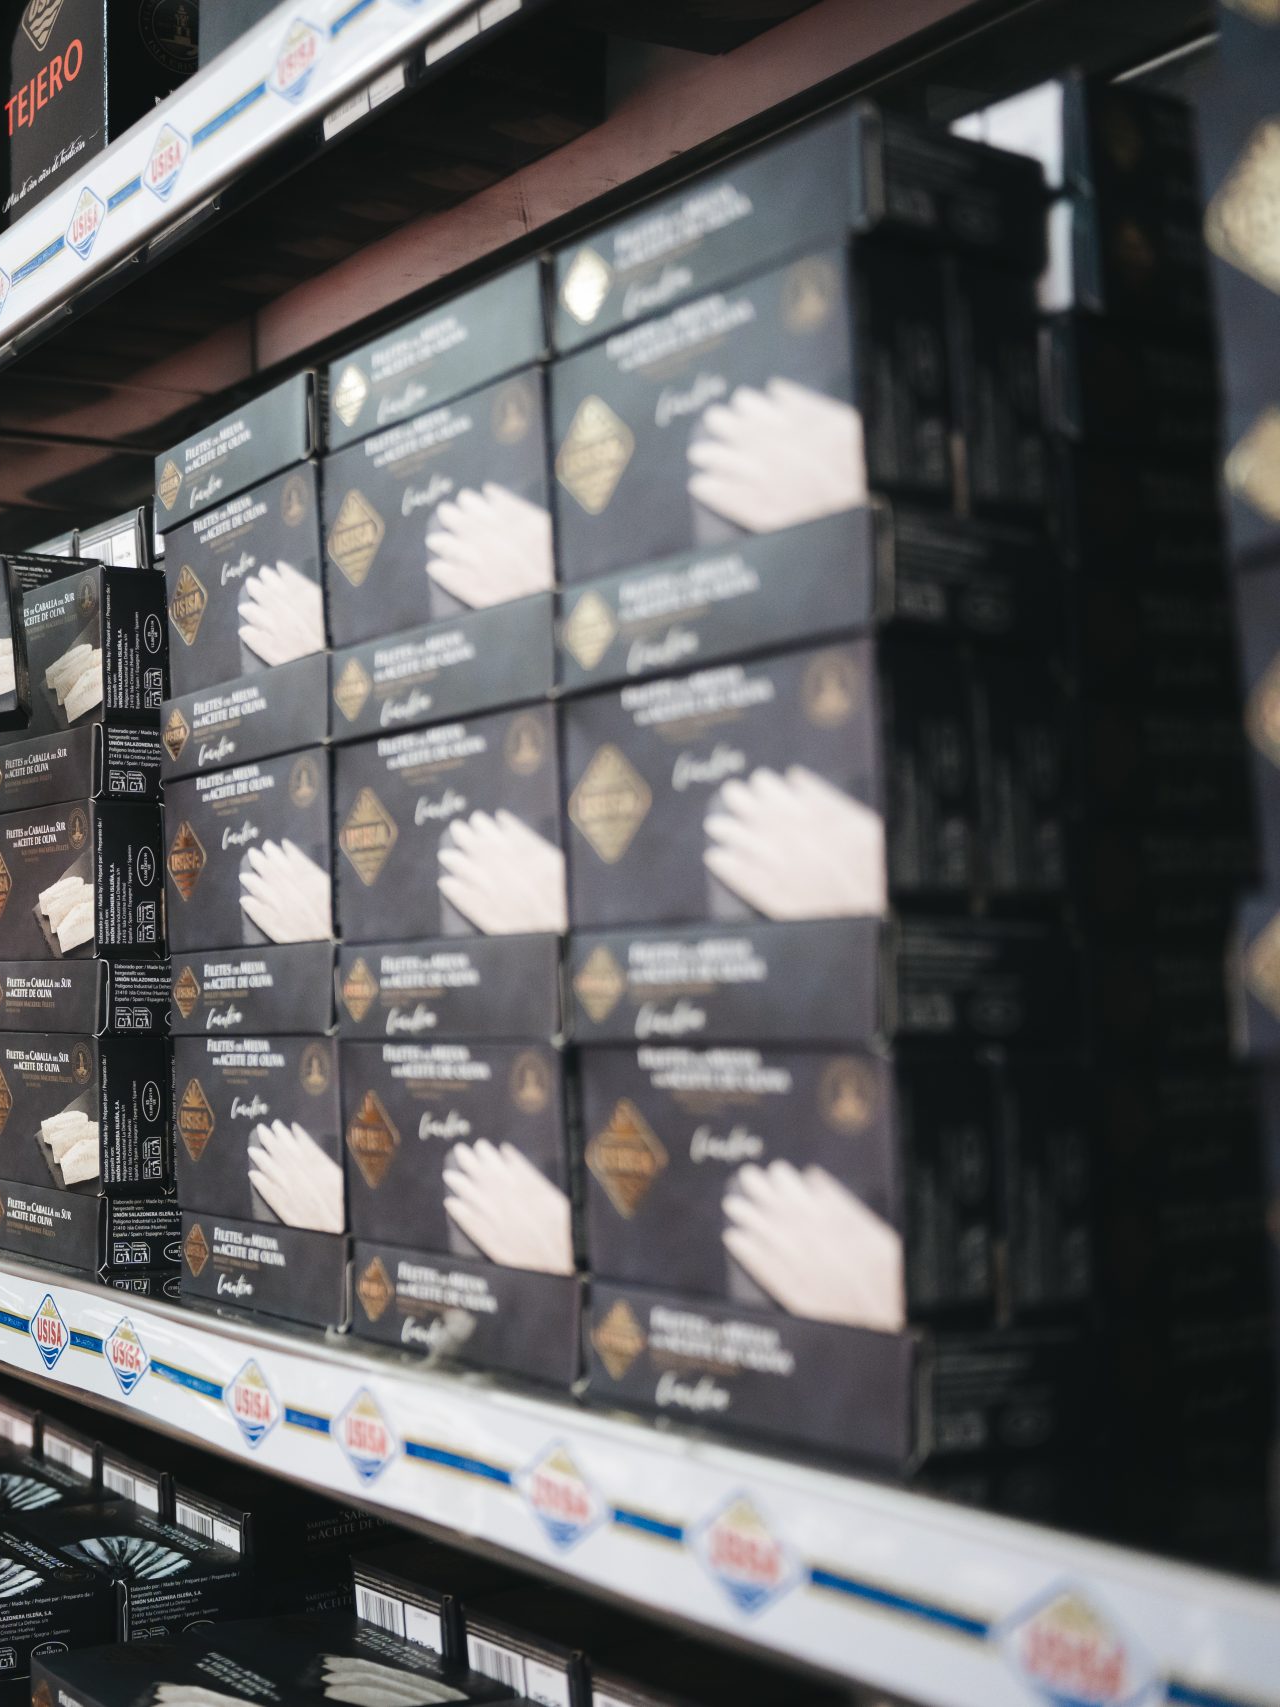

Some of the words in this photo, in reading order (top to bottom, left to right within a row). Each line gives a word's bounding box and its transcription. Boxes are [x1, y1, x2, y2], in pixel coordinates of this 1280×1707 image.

[278, 37, 316, 87] USISA
[5, 38, 83, 136] TEJERO
[150, 141, 182, 183] USISA
[72, 204, 99, 243] USISA
[5, 758, 23, 769] FILETES
[28, 752, 50, 764] CABALLA
[57, 748, 67, 758] SUR
[9, 767, 25, 777] ACEITE
[26, 765, 33, 774] DE
[34, 762, 49, 773] OLIVA
[6, 828, 23, 839] FILETES
[28, 825, 49, 835] CABALLA
[55, 821, 66, 831] SUR
[17, 837, 33, 847] ACEITE
[34, 836, 41, 844] DE
[42, 834, 56, 844] OLIVA
[6, 977, 25, 988] FILETES
[30, 977, 53, 988] CABALLA
[60, 977, 71, 988] SUR
[10, 988, 27, 998] ACEITE
[28, 989, 35, 998] DE
[36, 989, 52, 998] OLIVA
[6, 1048, 24, 1059] FILETES
[29, 1050, 52, 1061] CABALLA
[58, 1051, 70, 1063] SUR
[18, 1061, 35, 1070] ACEITE
[36, 1062, 43, 1071] DE
[44, 1062, 60, 1073] OLIVA
[7, 1197, 26, 1210] FILETES
[31, 1202, 54, 1216] CABALLA
[61, 1208, 72, 1220] SUR
[11, 1209, 28, 1221] ACEITE
[29, 1213, 36, 1223] DE
[37, 1214, 53, 1227] OLIVA
[36, 1316, 63, 1347] USISA
[111, 1336, 141, 1371] USISA
[234, 1388, 271, 1423] USISA
[345, 1417, 387, 1457] USISA
